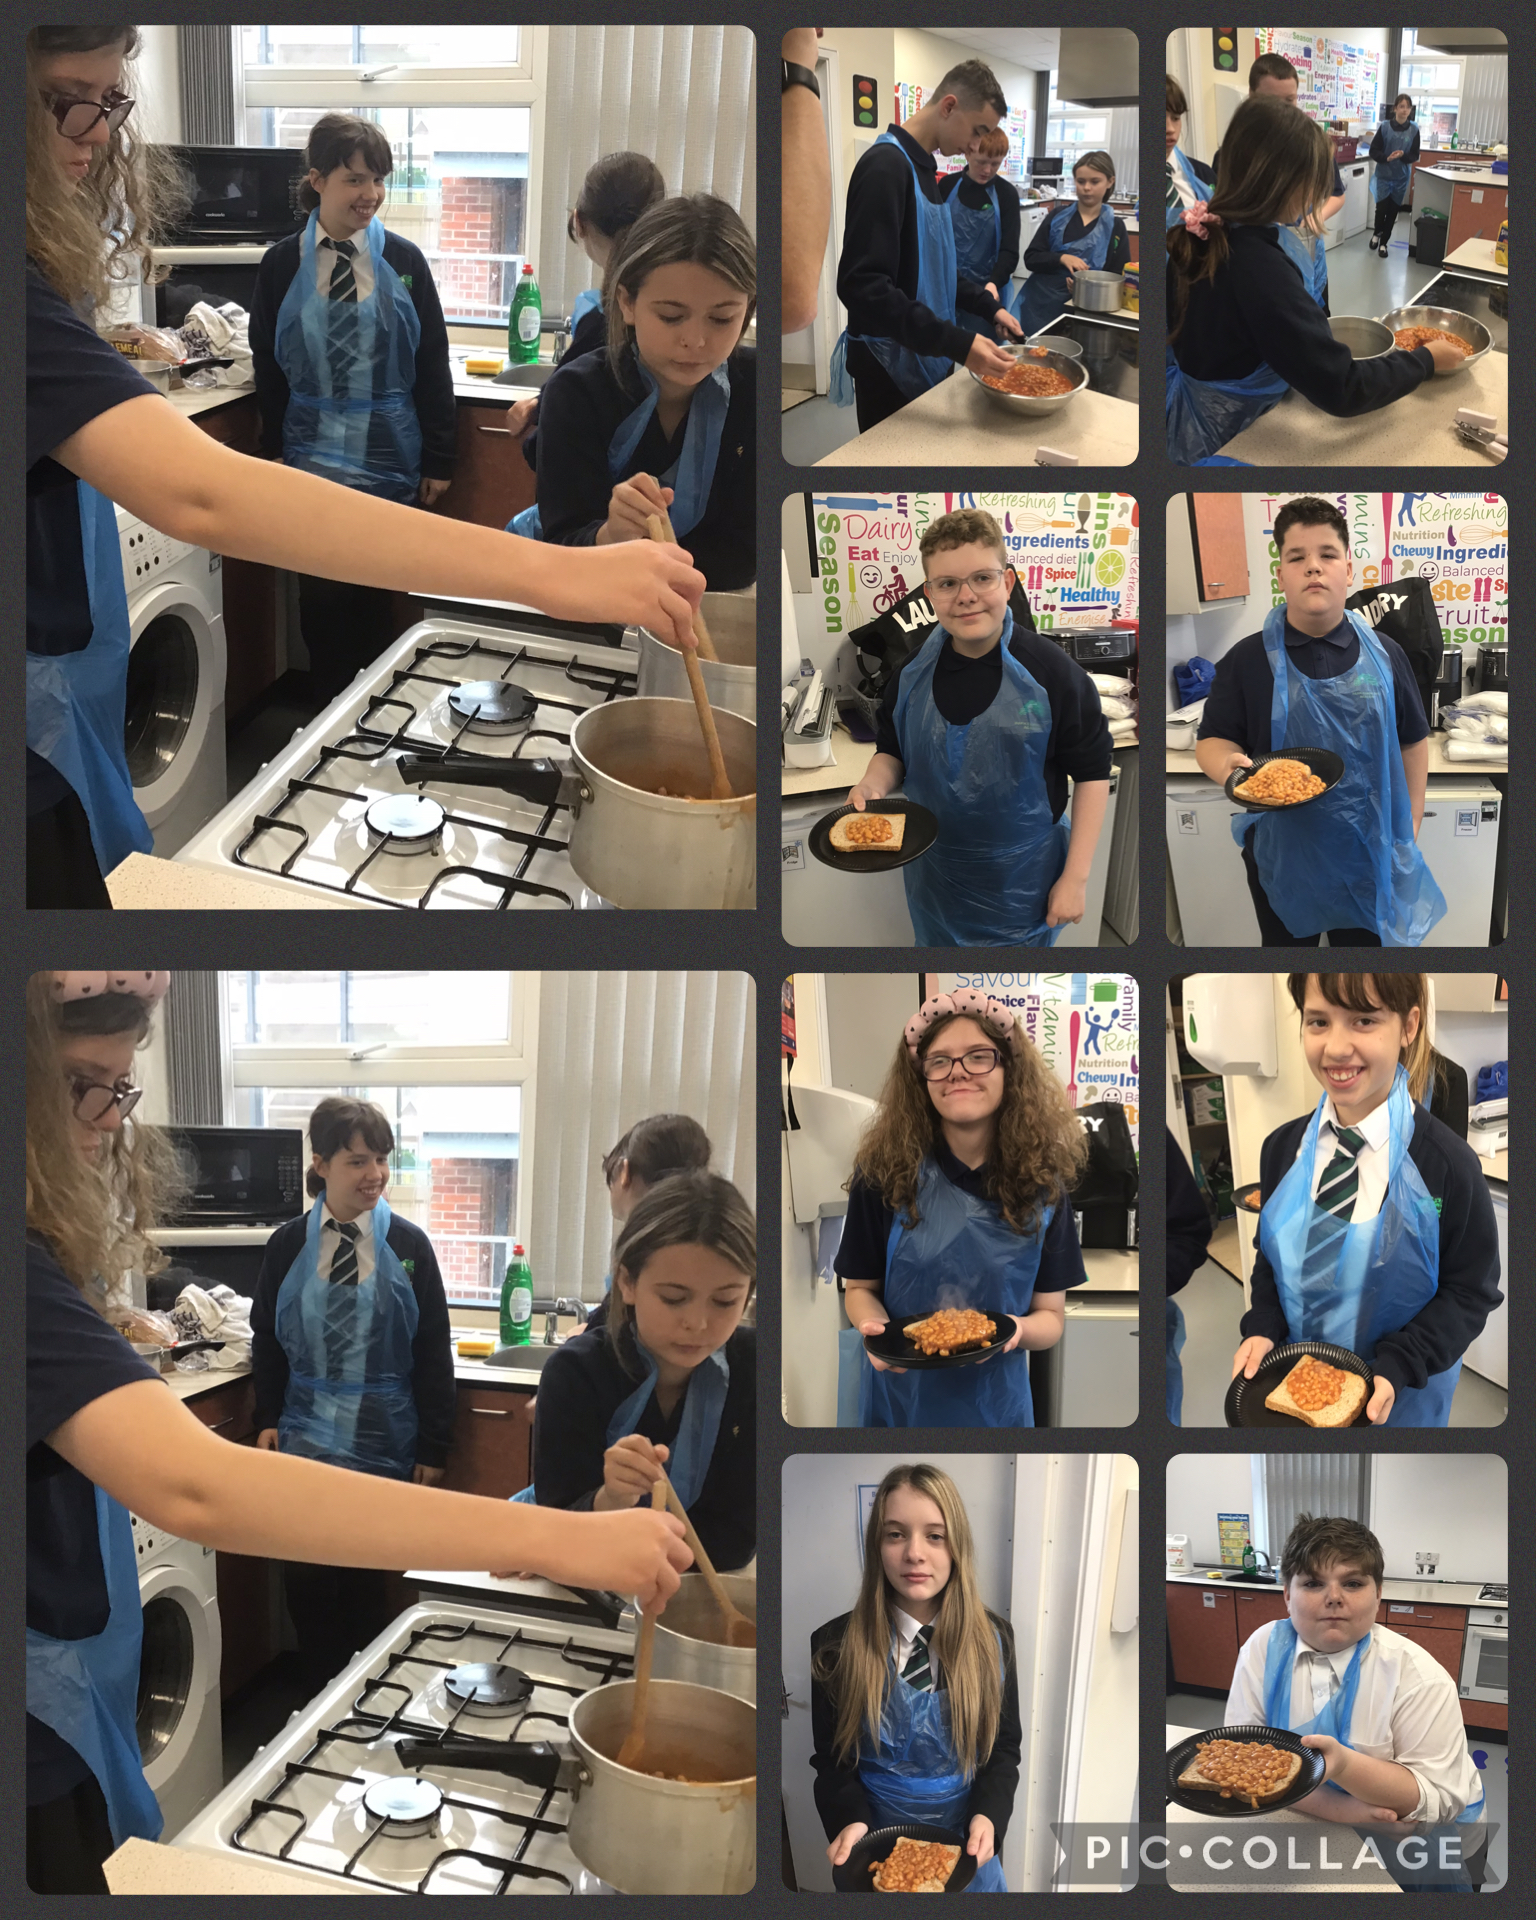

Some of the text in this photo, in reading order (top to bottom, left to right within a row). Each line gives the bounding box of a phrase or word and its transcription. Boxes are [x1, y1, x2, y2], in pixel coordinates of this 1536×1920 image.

[1292, 31, 1313, 43] Season
[1274, 38, 1303, 54] Hydrate
[1314, 71, 1336, 81] Energise
[1314, 84, 1323, 93] Eat
[1416, 501, 1508, 527] Refreshing
[843, 514, 913, 551] Dairy
[1392, 530, 1445, 541] Nutrition
[1002, 533, 1090, 551] ngredients
[848, 546, 880, 561] Eat
[883, 551, 918, 566] Enjoy
[1392, 544, 1434, 559] Chewy
[1436, 544, 1508, 564] Ingredi
[1056, 554, 1077, 565] diet
[817, 512, 843, 633] Season
[1045, 567, 1077, 582] Spice
[1442, 564, 1504, 577] Balanced
[1060, 587, 1120, 605] Healthy
[1059, 611, 1106, 627] Energise
[956, 973, 1038, 988] Savour
[1117, 977, 1137, 1032] Family
[1078, 1059, 1128, 1068] Nutrition
[1077, 1071, 1118, 1086] Chewy
